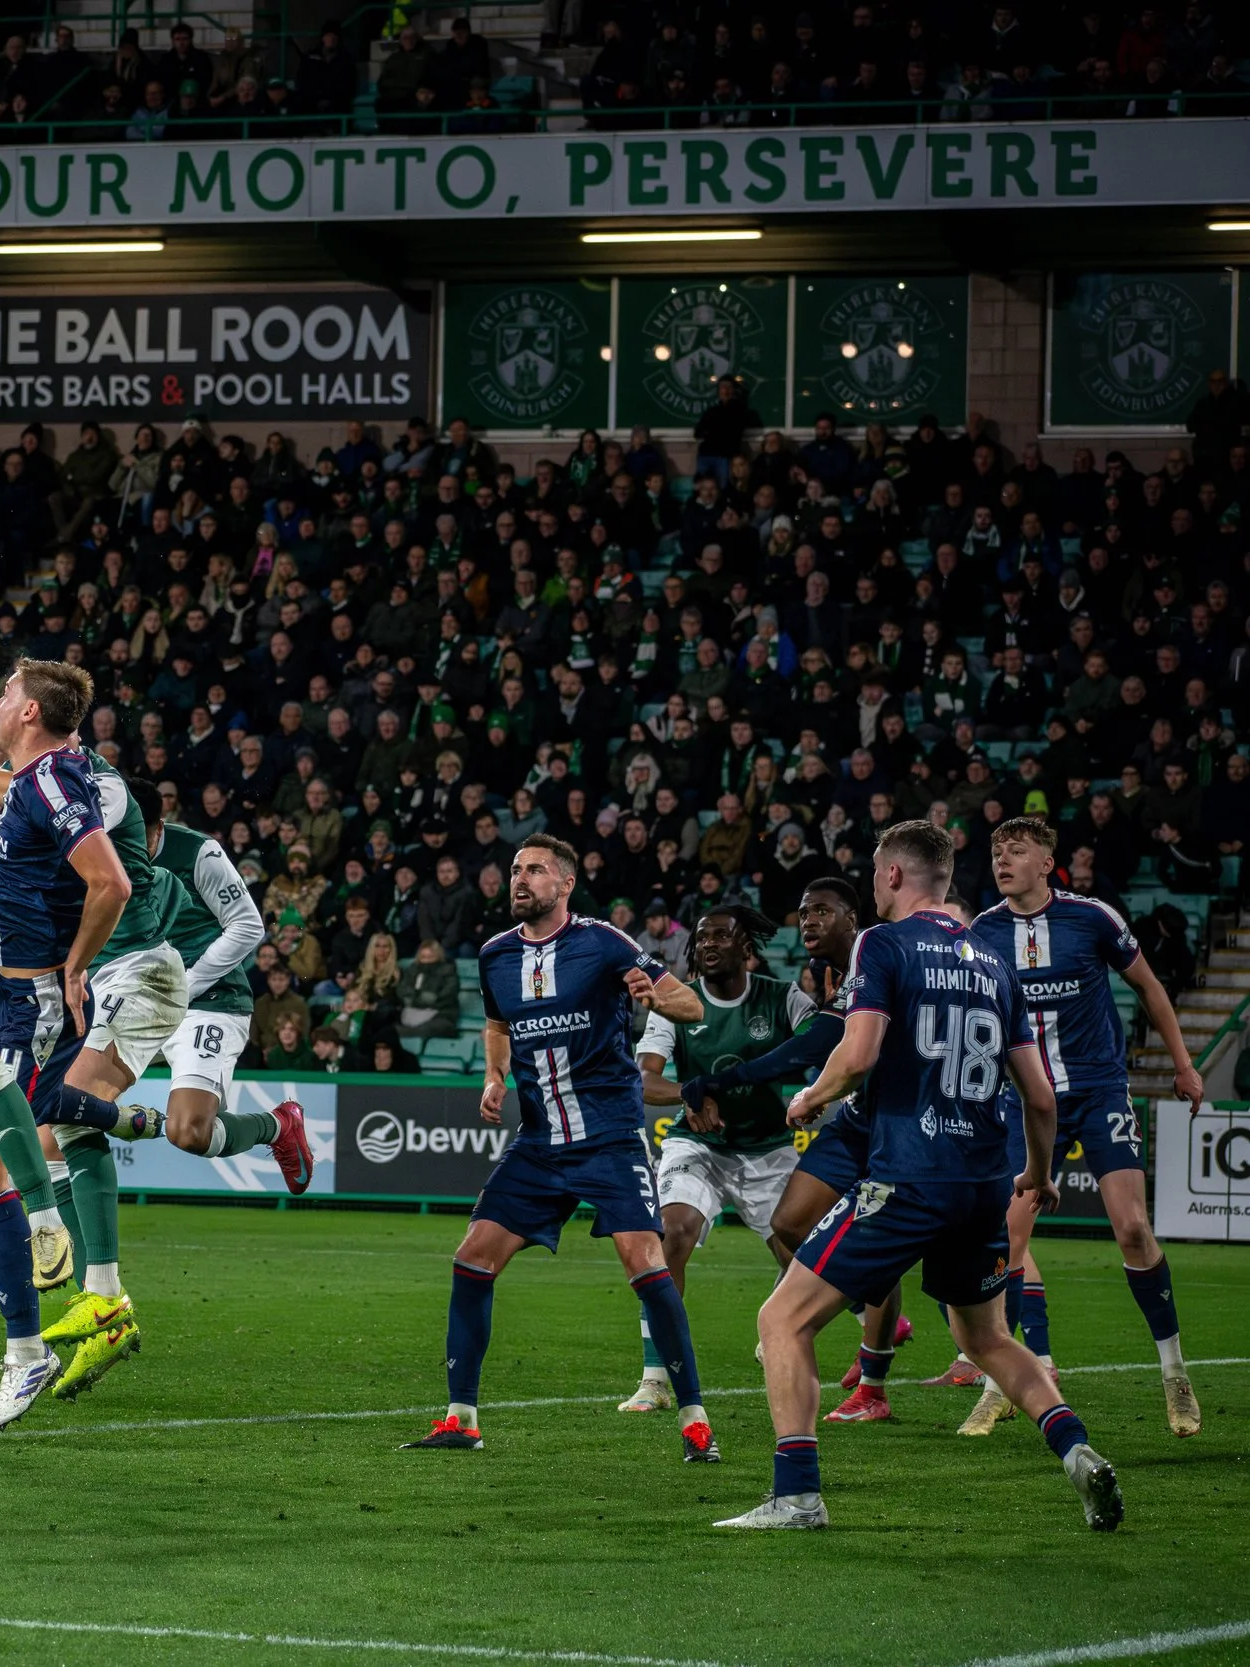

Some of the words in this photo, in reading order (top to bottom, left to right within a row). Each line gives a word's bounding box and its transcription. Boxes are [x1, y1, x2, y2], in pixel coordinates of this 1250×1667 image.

[168, 146, 521, 214] MOTTO,
[563, 130, 1098, 207] PERSEVERE
[55, 306, 198, 364] BALL
[211, 304, 411, 363] ROOM
[62, 374, 152, 407] BARS
[161, 374, 185, 406] &
[194, 373, 292, 406] POOL
[302, 372, 412, 405] HALLS
[218, 879, 249, 905] SBK
[916, 941, 952, 953] Drain
[925, 968, 998, 1000] HAMILTON
[1021, 980, 1080, 996] ROWN
[101, 994, 125, 1024] 4
[515, 1010, 590, 1033] CROWN
[194, 1024, 223, 1053] 18
[547, 1025, 569, 1034] services
[570, 1022, 591, 1031] limited
[916, 1004, 1003, 1102] 48
[74, 1095, 87, 1120] DFC
[944, 1118, 974, 1131] ALPHA
[1107, 1112, 1143, 1143] 22
[406, 1118, 510, 1162] bevvy
[632, 1165, 654, 1198] 3
